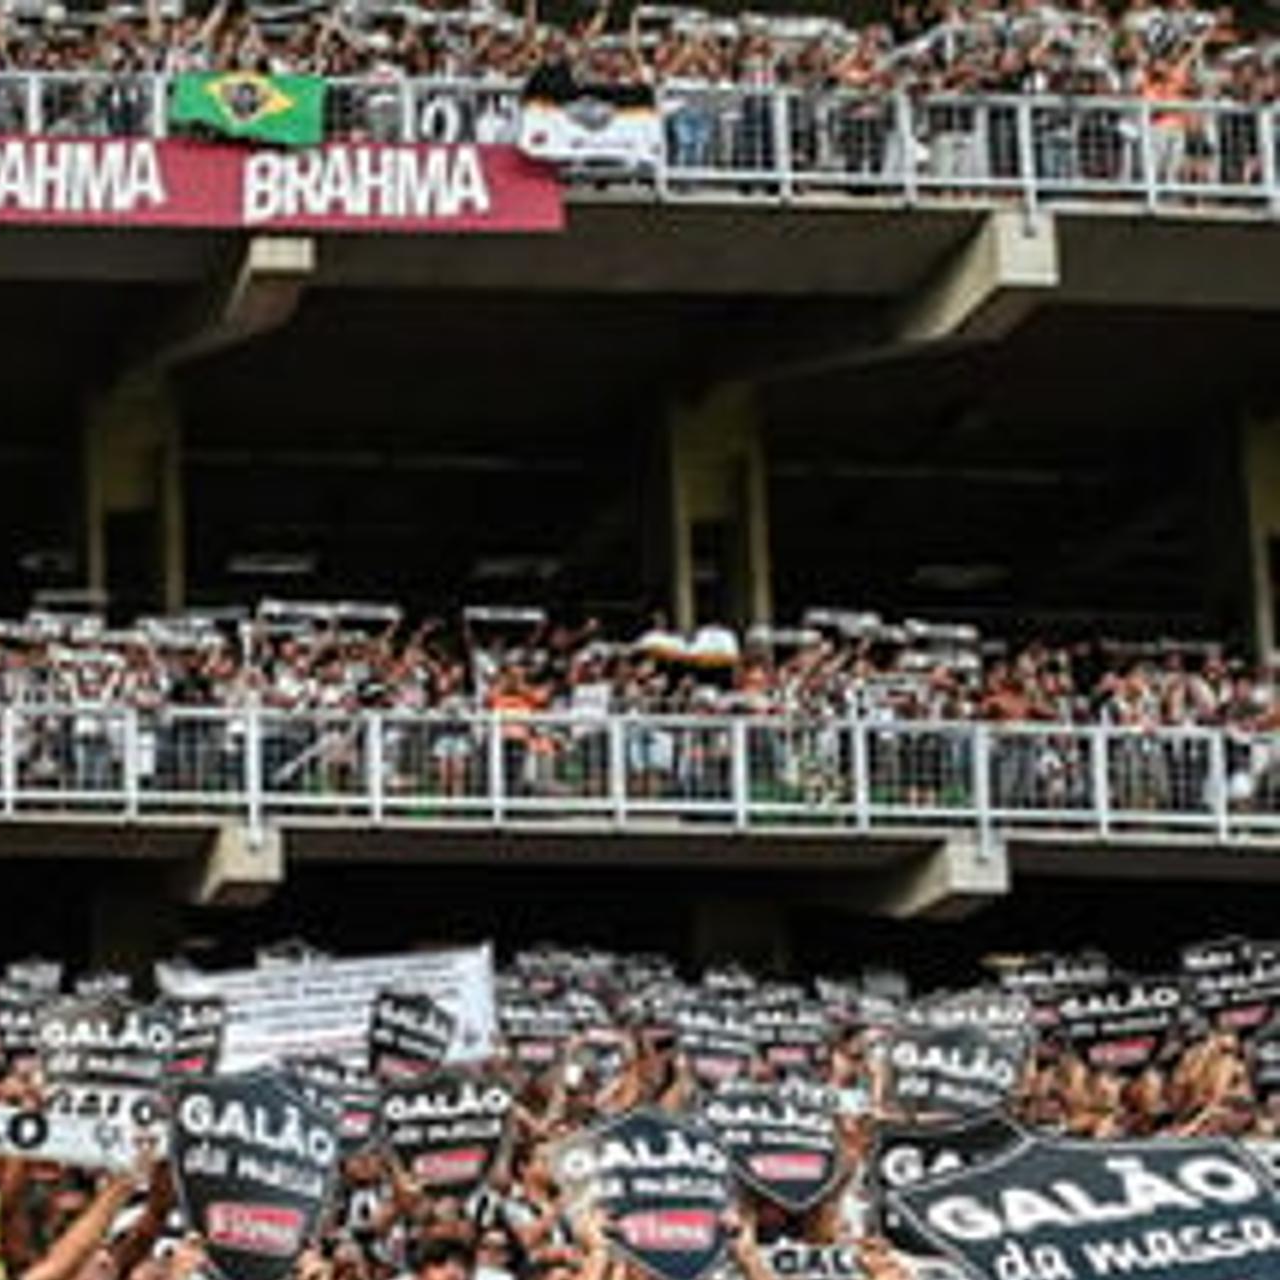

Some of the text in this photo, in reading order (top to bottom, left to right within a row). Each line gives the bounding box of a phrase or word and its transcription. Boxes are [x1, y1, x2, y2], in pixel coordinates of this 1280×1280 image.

[242, 144, 490, 222] BRAHMA
[42, 1009, 173, 1050] GALÃO
[891, 1039, 1015, 1088] GALÃO
[385, 1080, 512, 1122] GALÃO
[182, 1094, 336, 1166] GALÃO
[562, 1129, 729, 1176] GALÃO
[928, 1155, 1259, 1241] GALÃO
[1082, 1215, 1280, 1278] massa
